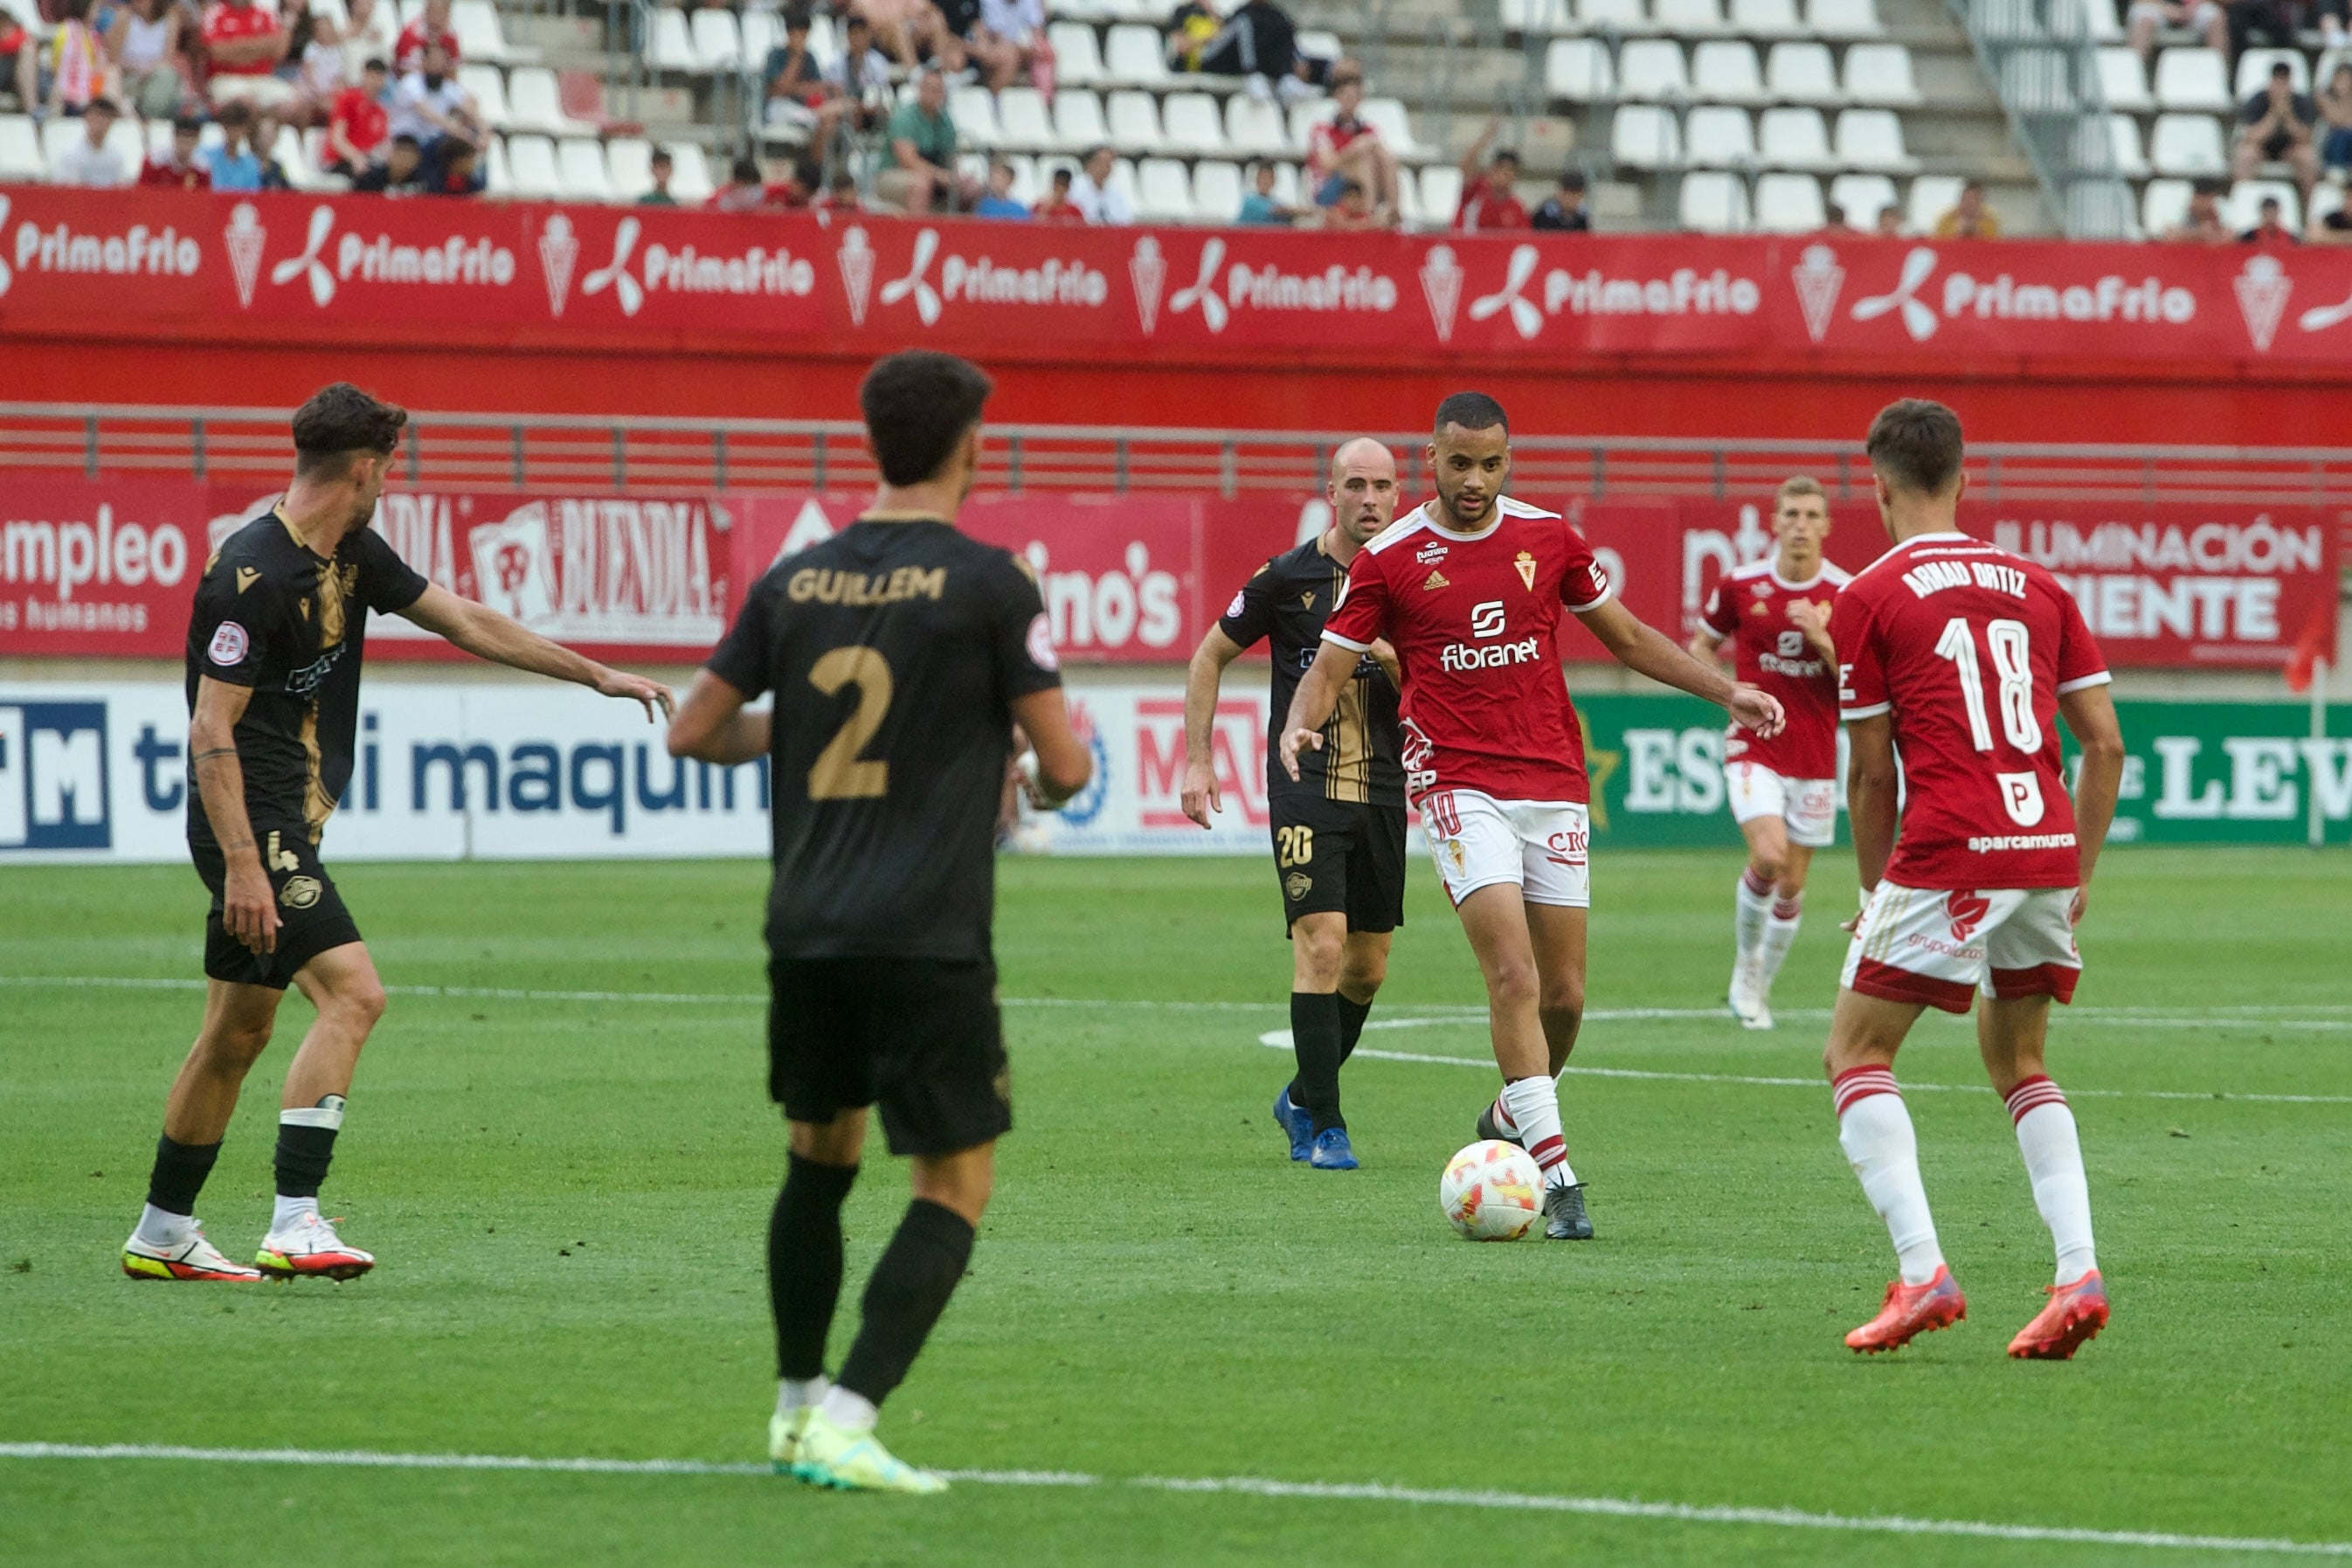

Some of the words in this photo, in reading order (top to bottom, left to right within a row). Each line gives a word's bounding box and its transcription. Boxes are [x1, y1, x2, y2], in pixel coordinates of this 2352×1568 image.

[0, 501, 187, 604] mpleo
[788, 566, 947, 604] GUILLEM
[1901, 561, 1972, 599] ARNAU
[1970, 562, 2027, 599] ORTIZ
[1440, 636, 1539, 672] fibranet
[1934, 618, 2043, 754] 18
[807, 645, 895, 801] 2
[1426, 791, 1462, 841] 10
[267, 830, 300, 872] 4
[1277, 825, 1313, 868] 20
